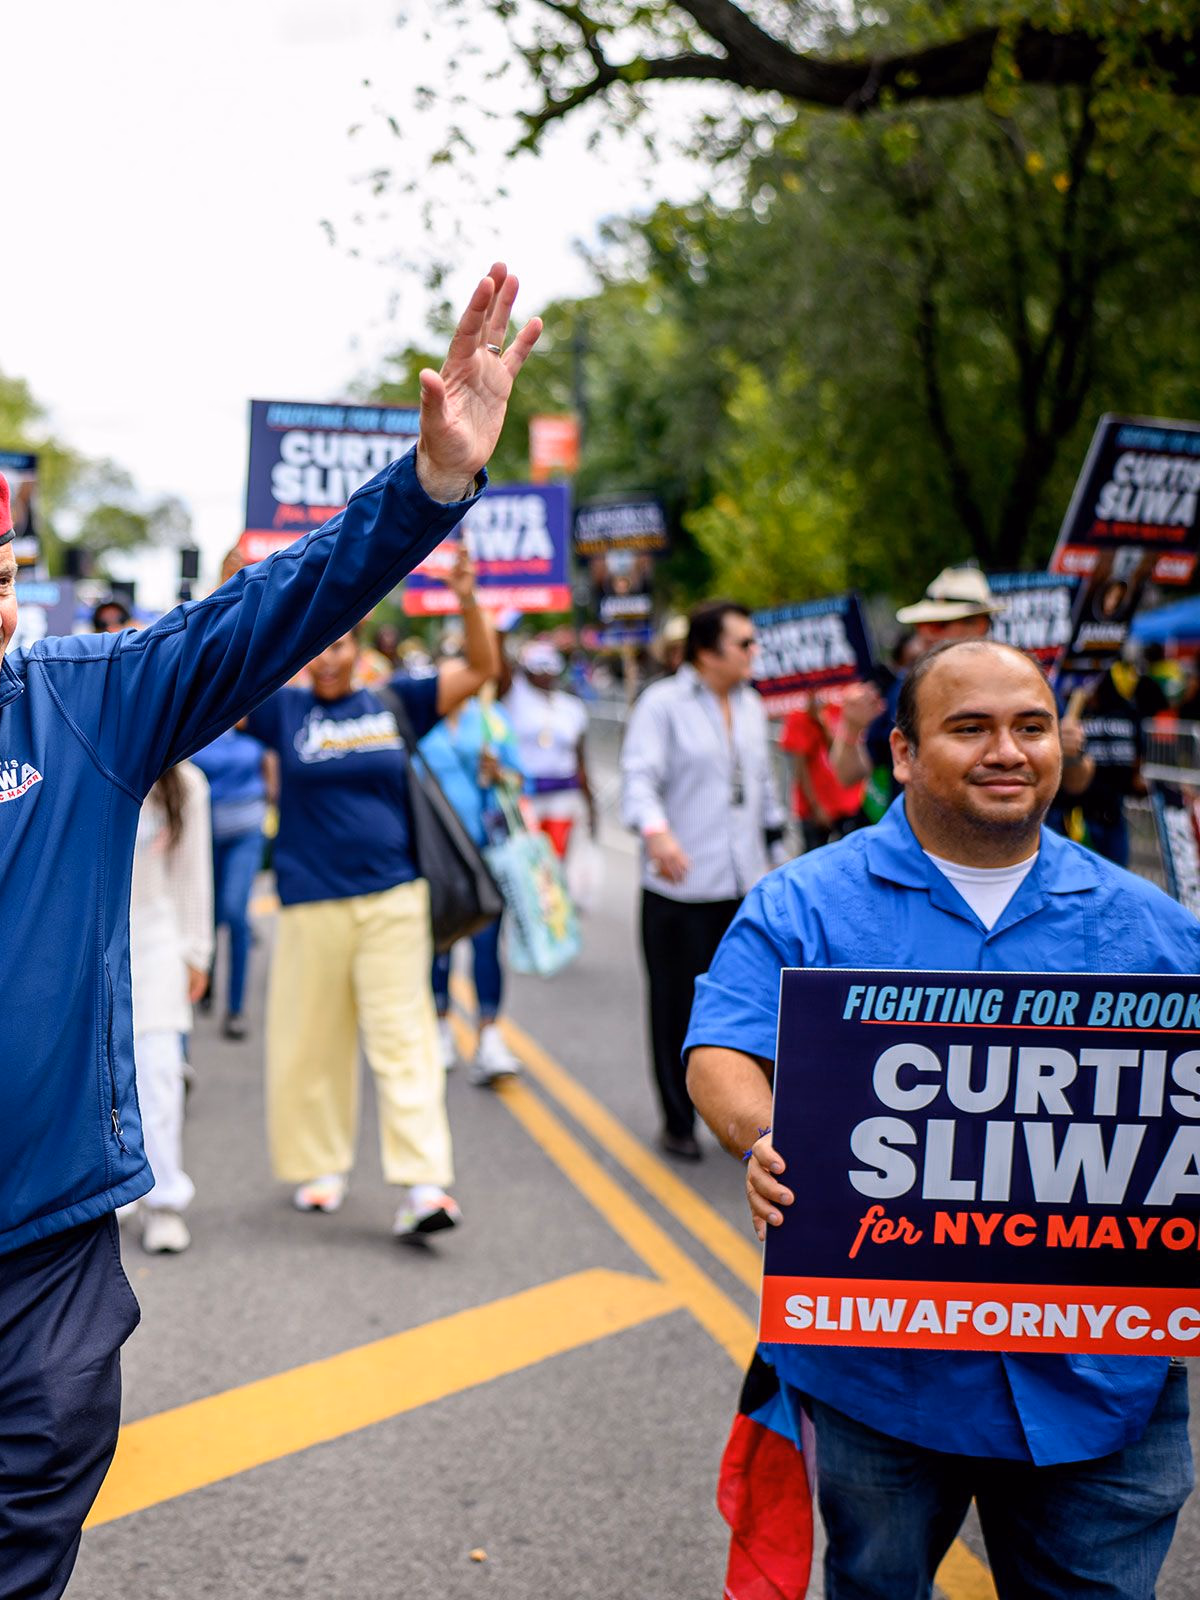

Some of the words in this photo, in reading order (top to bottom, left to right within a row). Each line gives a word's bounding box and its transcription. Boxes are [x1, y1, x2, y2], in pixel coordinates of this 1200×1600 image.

[7, 774, 39, 799] MAYOR
[843, 984, 1003, 1024] FIGHTING
[1011, 989, 1080, 1026] FOR
[872, 1043, 1200, 1119] CURTIS
[848, 1116, 1200, 1206] SLIWA
[848, 1204, 923, 1259] for
[933, 1211, 1037, 1246] NYC
[1046, 1215, 1200, 1251] MAYO
